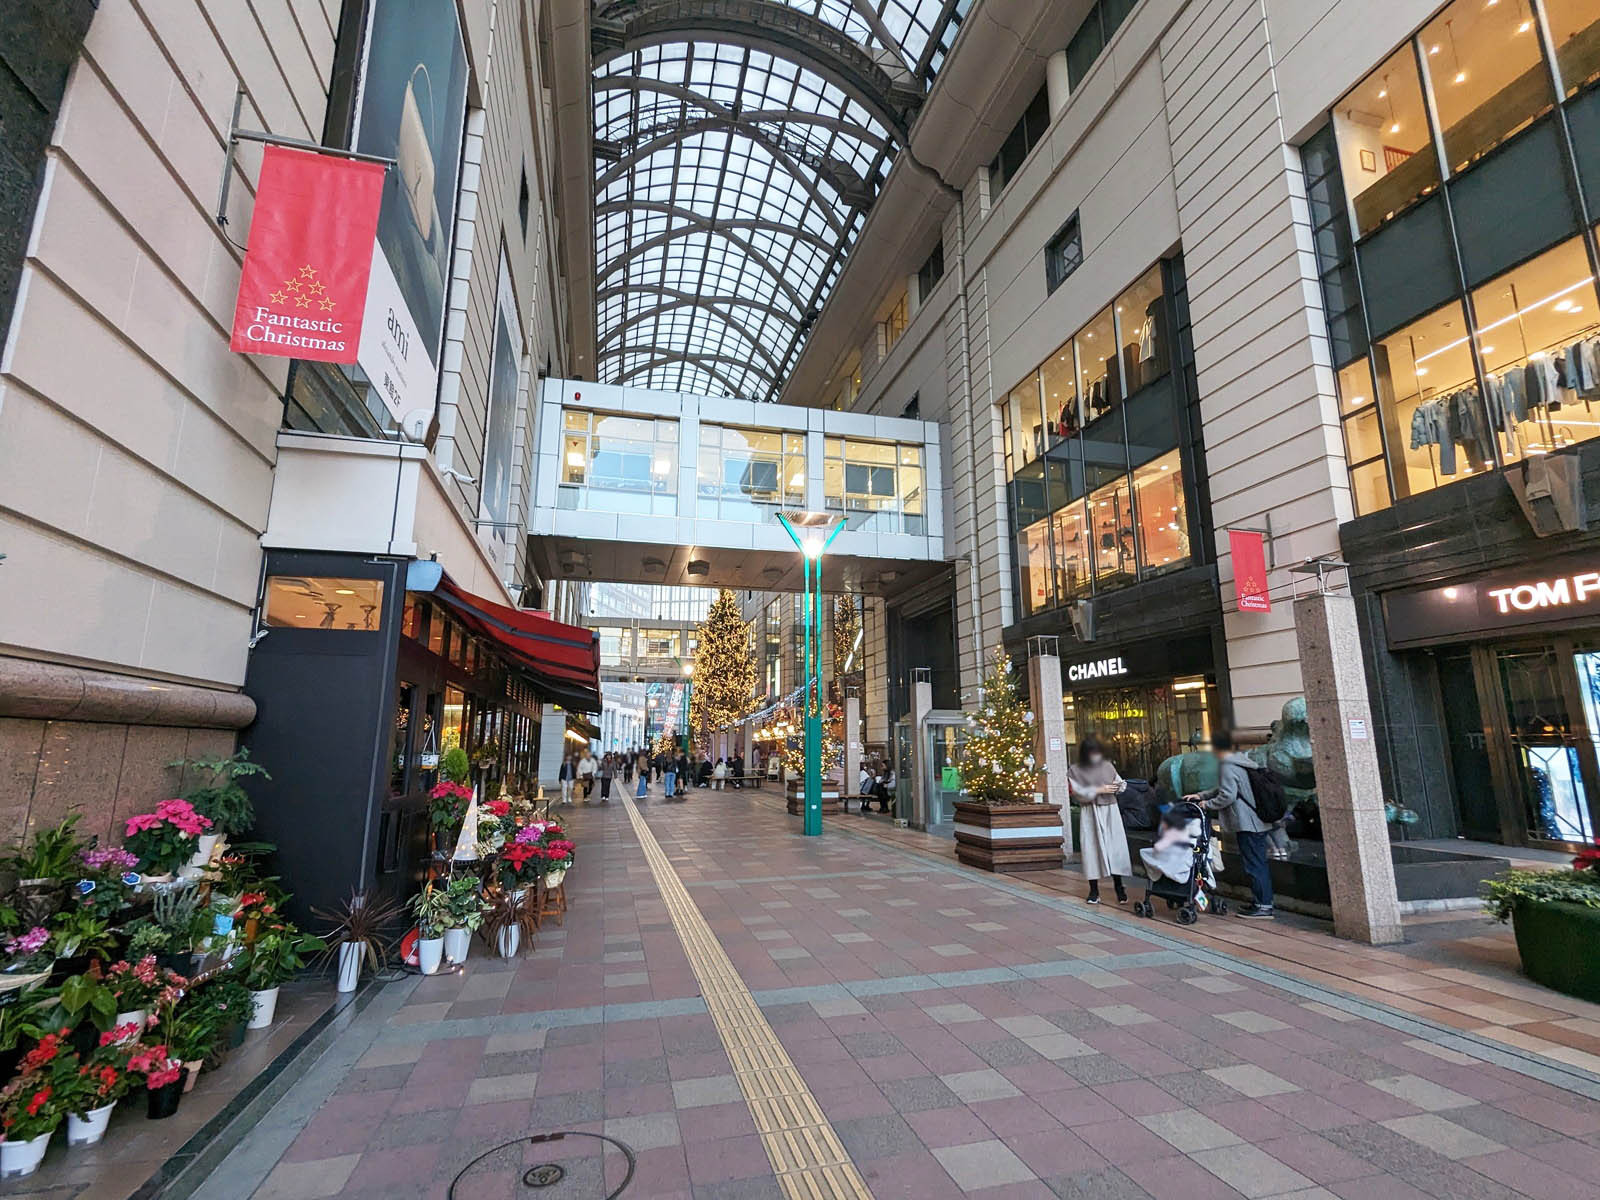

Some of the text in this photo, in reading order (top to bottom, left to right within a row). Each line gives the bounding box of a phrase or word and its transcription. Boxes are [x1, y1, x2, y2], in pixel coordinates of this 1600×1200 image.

[254, 306, 343, 334] Fantastic
[387, 307, 409, 361] ami
[247, 324, 346, 351] Christmas
[1488, 572, 1600, 613] TOM F
[1068, 656, 1128, 681] CHANEL
